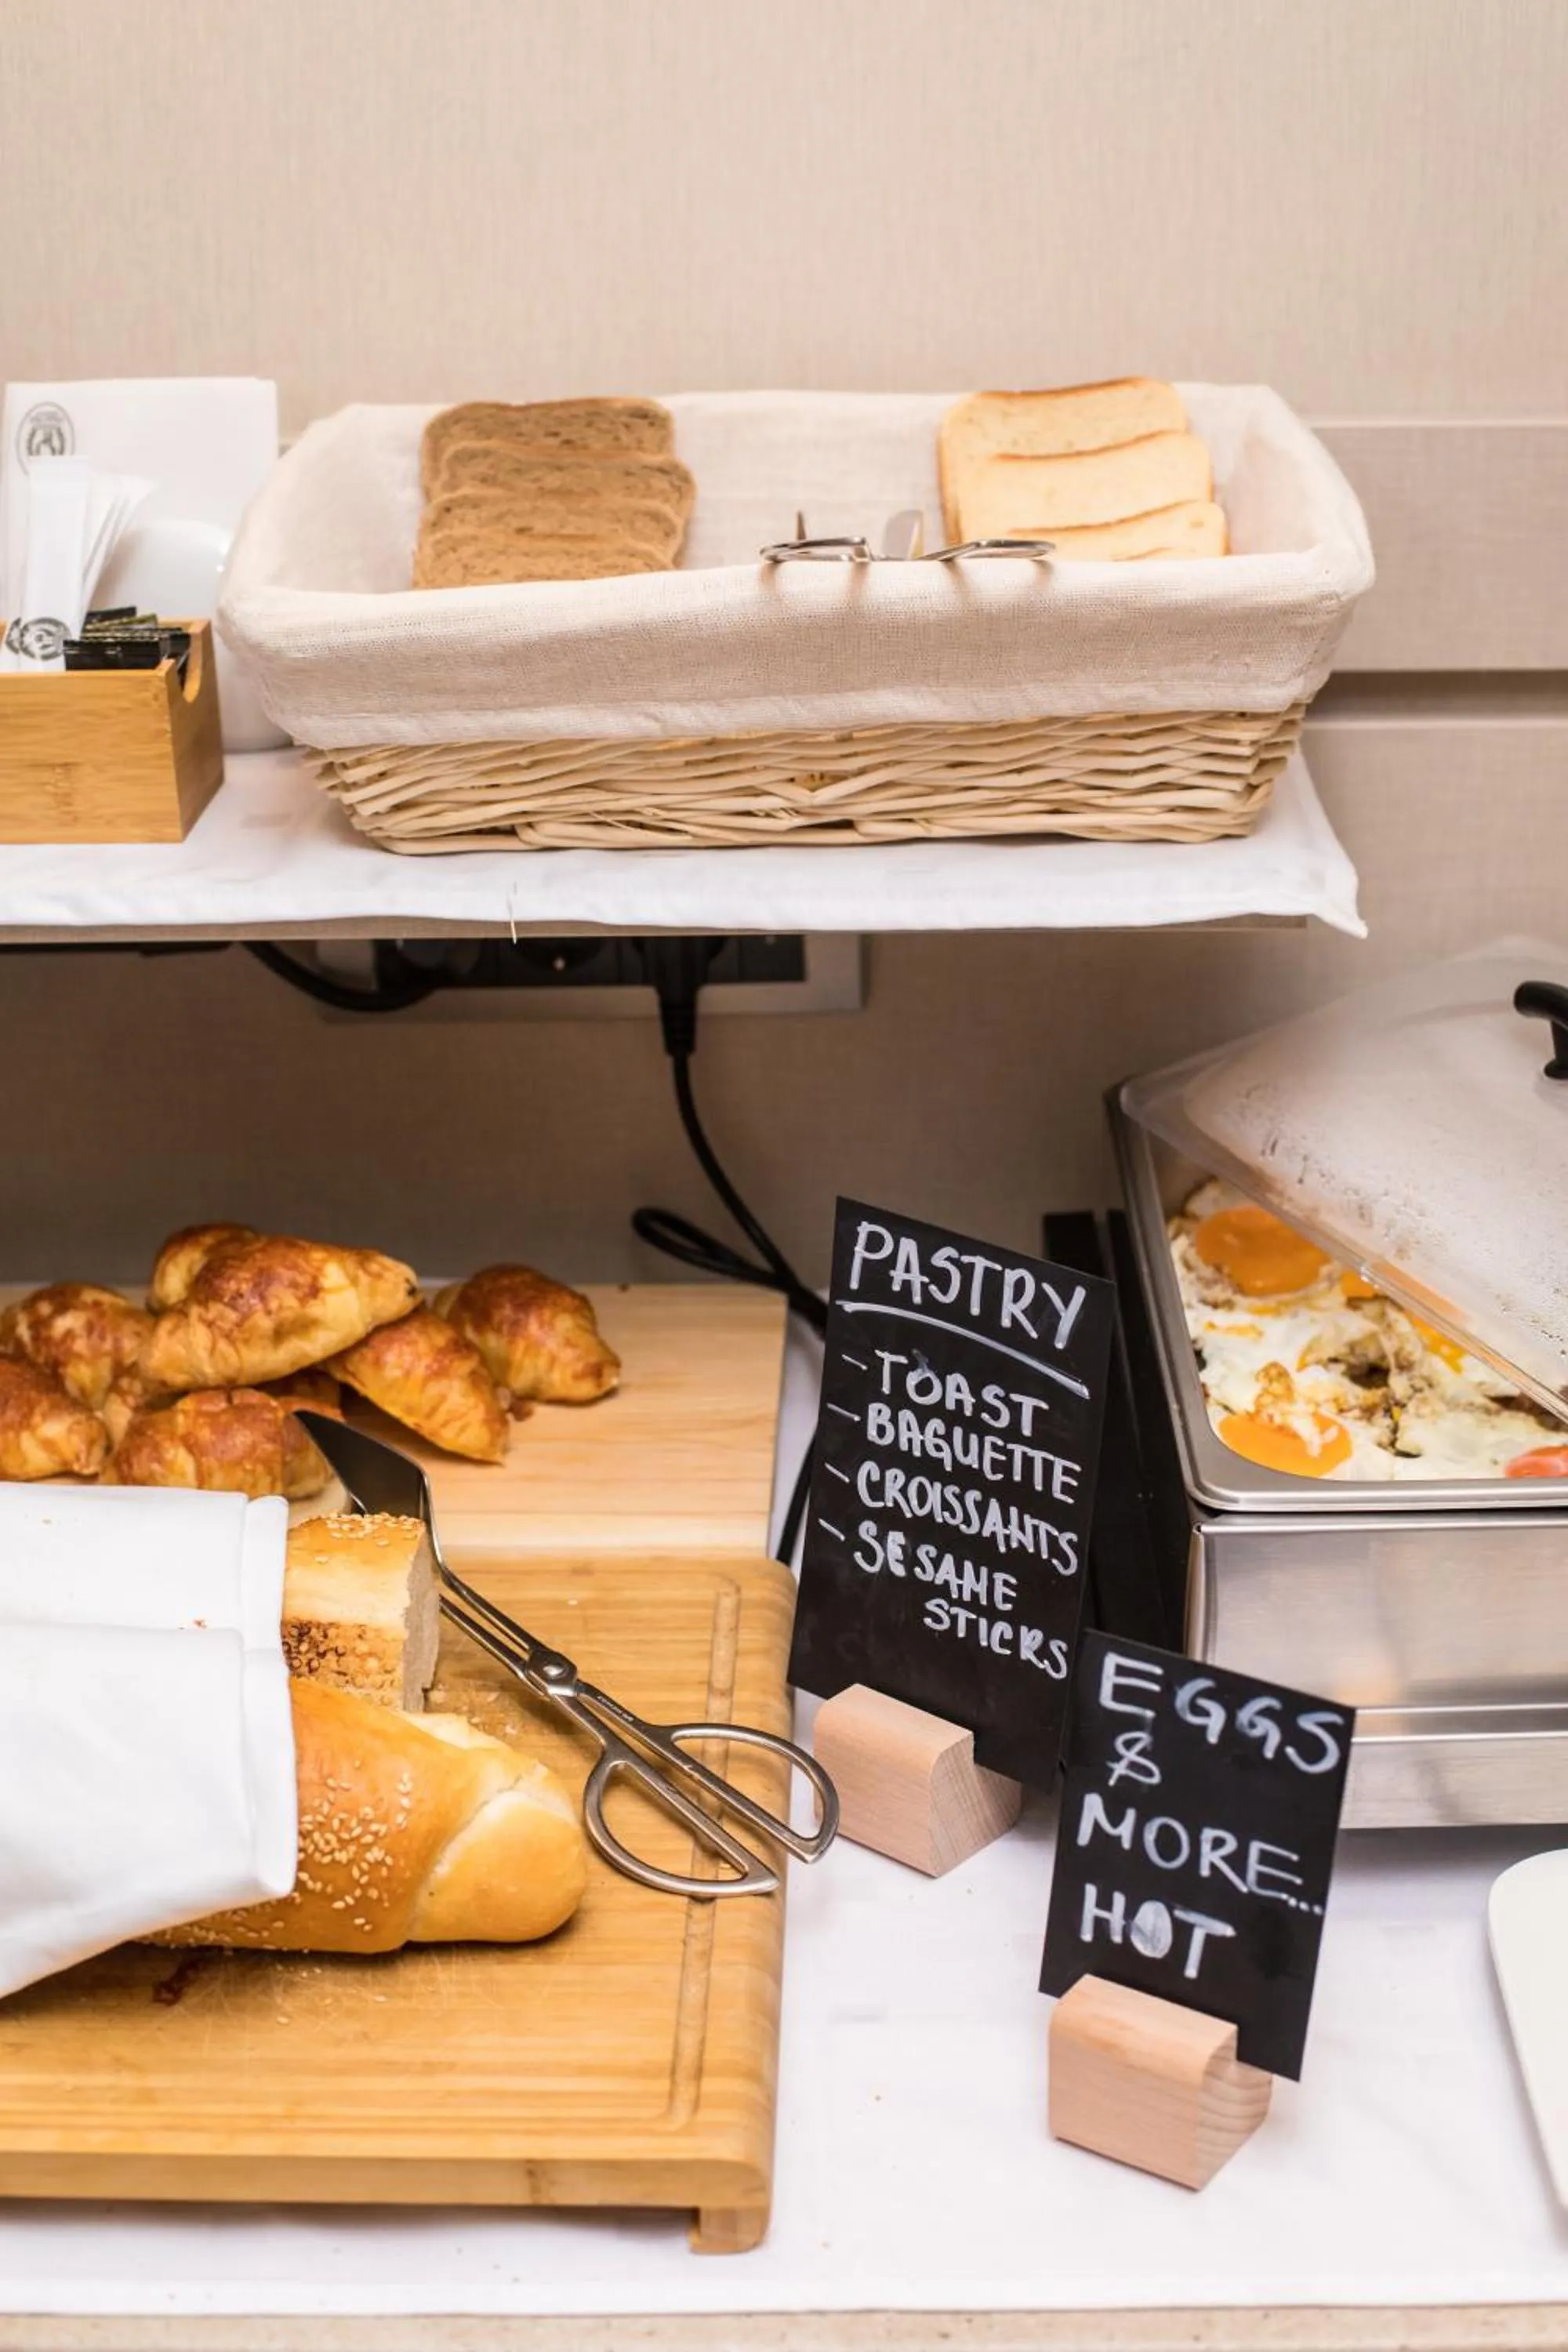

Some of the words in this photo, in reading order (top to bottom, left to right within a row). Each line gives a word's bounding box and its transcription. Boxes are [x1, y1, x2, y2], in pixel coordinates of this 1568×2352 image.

[850, 1221, 1087, 1349] PASTRY
[875, 1349, 1049, 1437] TOAST
[867, 1403, 1081, 1503] BAGUETTE
[857, 1461, 1079, 1576] CROISSANTS
[1100, 1652, 1345, 1773] EGGS
[1106, 1730, 1162, 1787] &
[1080, 1883, 1236, 1979] HOT
